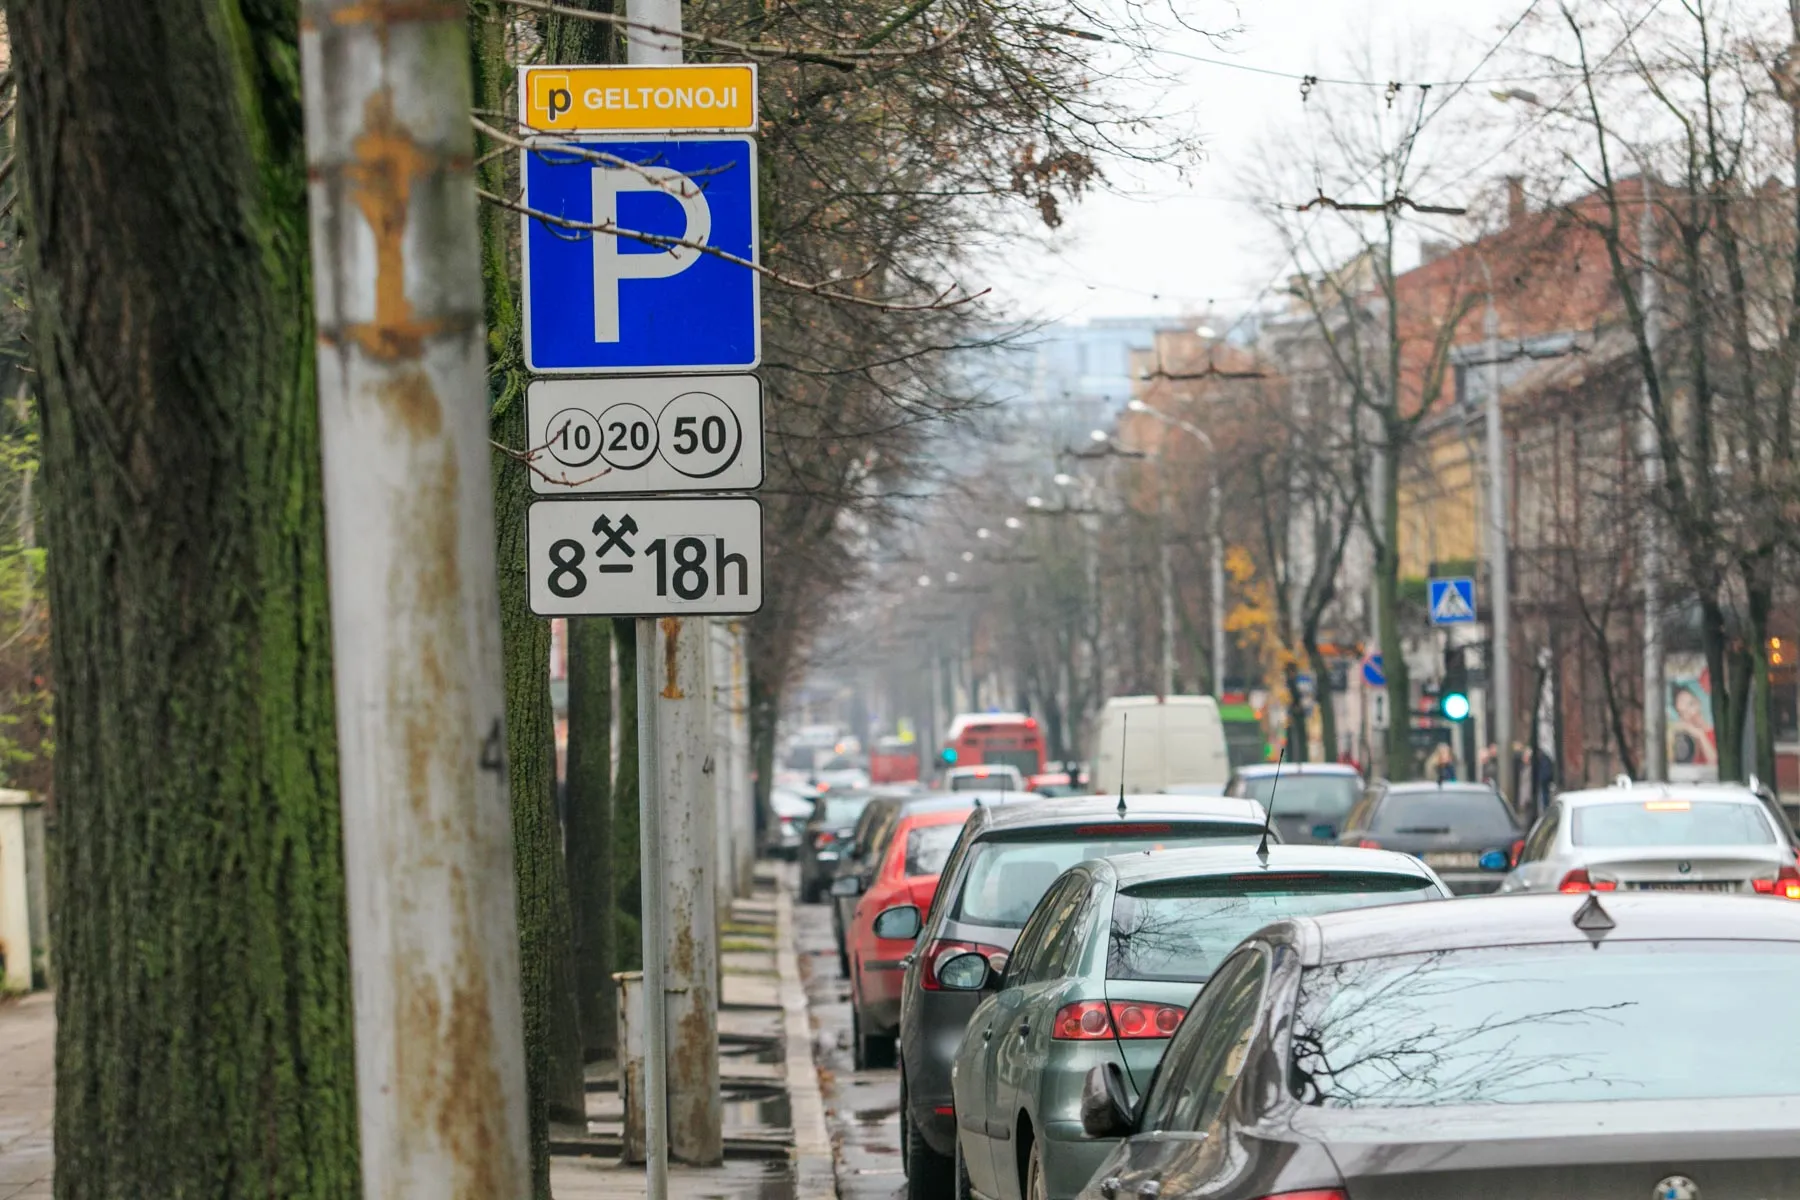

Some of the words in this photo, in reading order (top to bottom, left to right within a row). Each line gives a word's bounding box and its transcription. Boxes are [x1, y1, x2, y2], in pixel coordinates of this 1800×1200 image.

[583, 87, 737, 110] GELTONOJI
[591, 166, 711, 343] P
[560, 424, 591, 450] 10
[608, 421, 649, 451] 20
[673, 415, 727, 454] 50
